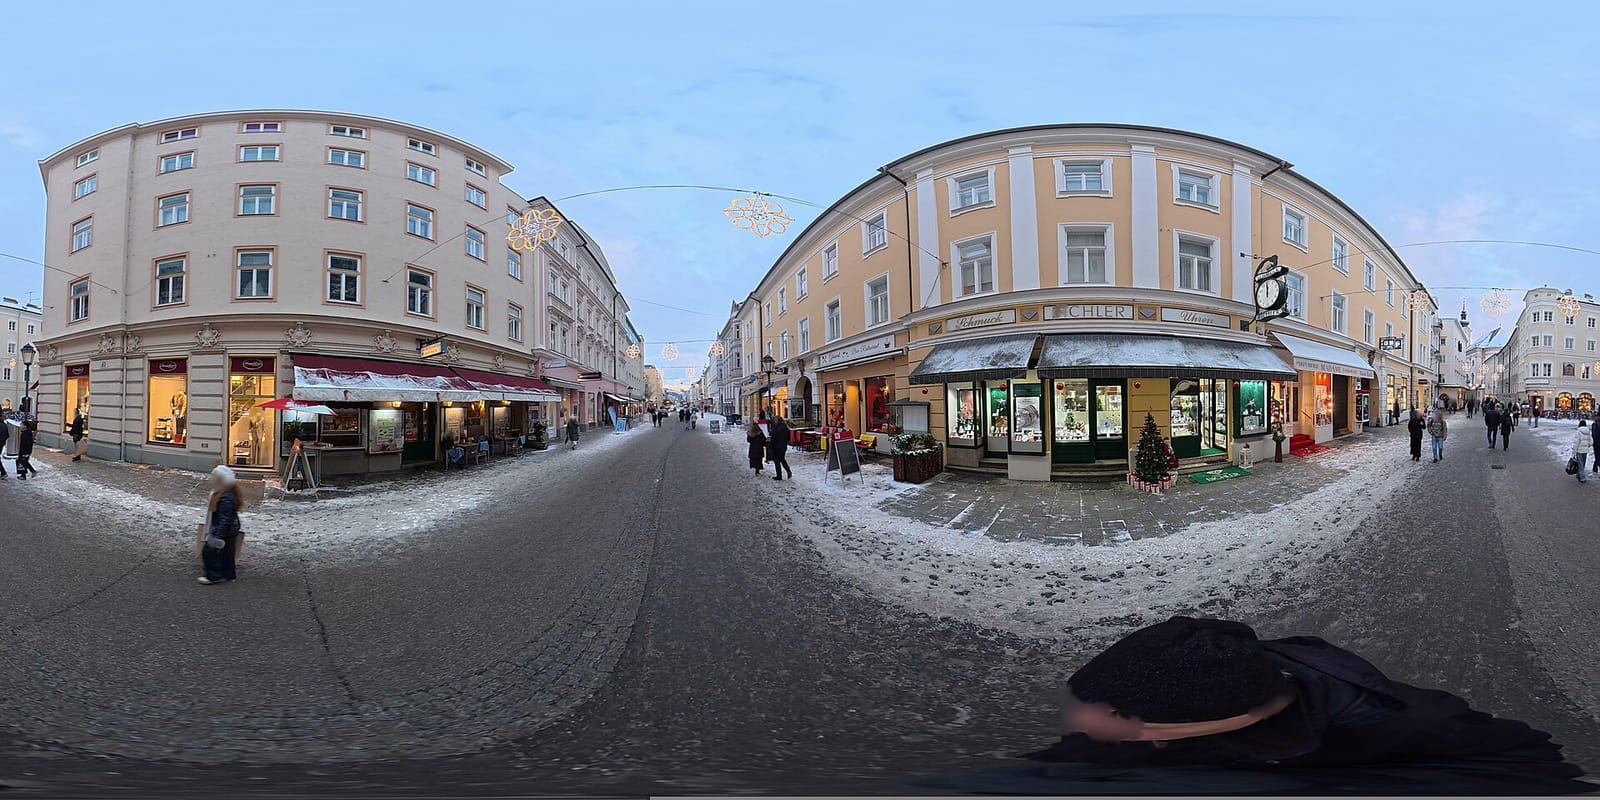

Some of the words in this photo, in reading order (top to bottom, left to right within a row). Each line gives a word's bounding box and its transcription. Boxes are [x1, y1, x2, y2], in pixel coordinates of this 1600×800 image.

[1052, 305, 1125, 318] CHLER
[1180, 311, 1214, 324] Uhren
[955, 312, 1003, 328] Schmuck
